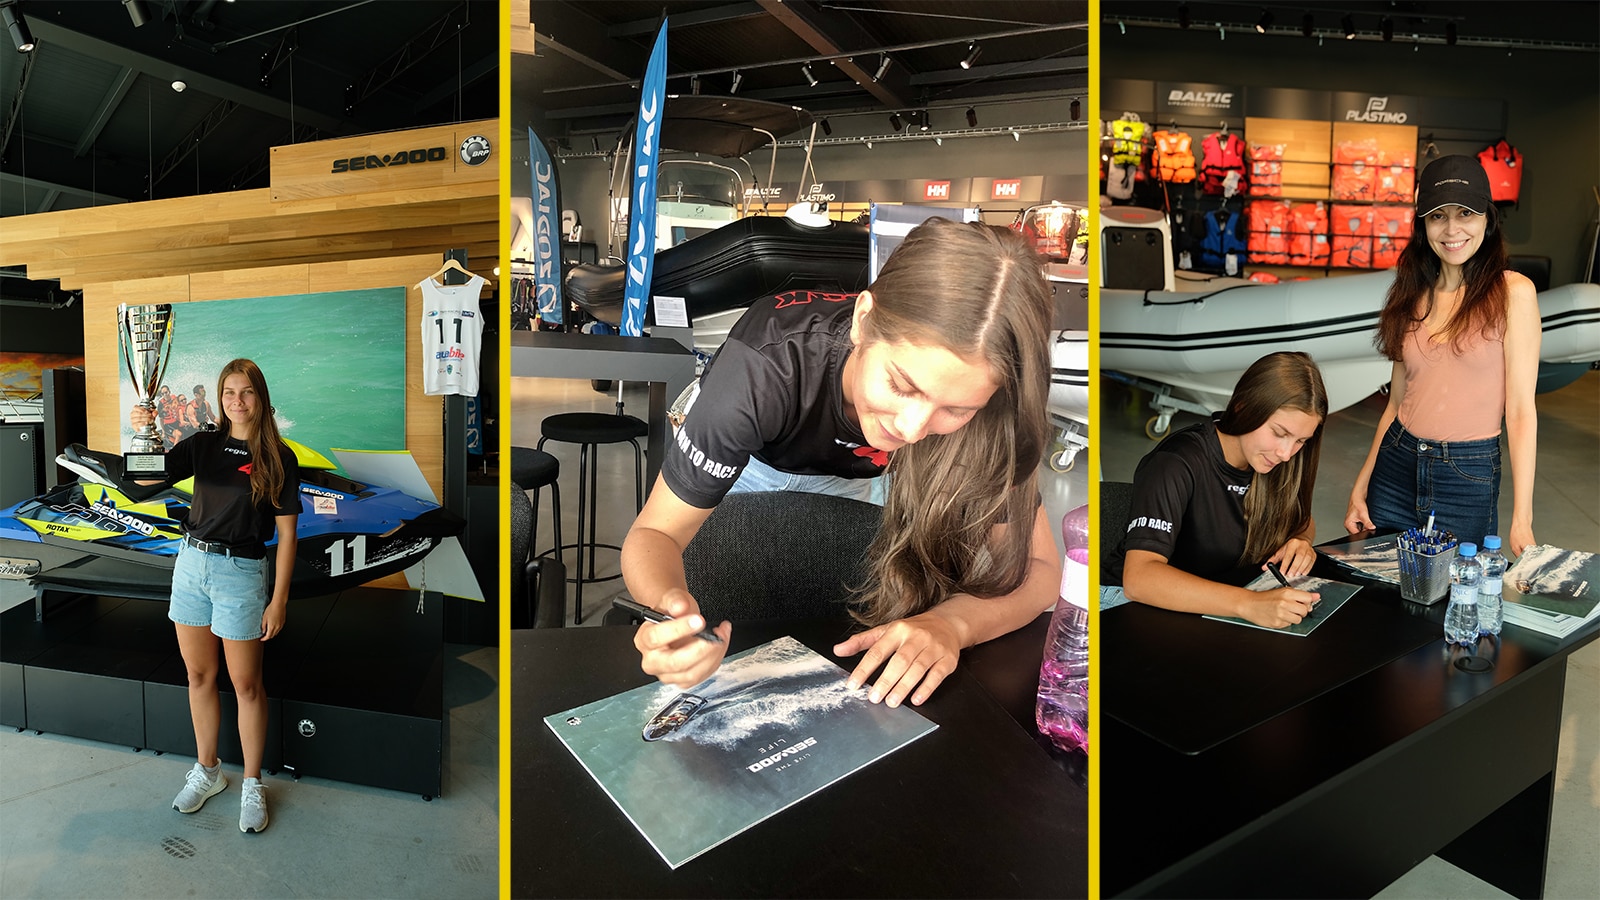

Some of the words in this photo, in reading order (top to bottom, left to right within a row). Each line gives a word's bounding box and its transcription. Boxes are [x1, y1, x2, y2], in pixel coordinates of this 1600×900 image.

[1168, 90, 1233, 103] BALTIC
[1346, 110, 1407, 124] PLASTIMO
[472, 149, 489, 158] BRP
[927, 184, 946, 197] HH
[995, 183, 1017, 196] HH
[224, 447, 248, 456] regio
[688, 447, 701, 468] TO
[46, 524, 70, 533] ROTAX
[1137, 516, 1148, 527] TO
[1148, 518, 1173, 533] RACE
[324, 535, 367, 577] 11
[758, 738, 787, 754] LIFE
[775, 762, 792, 772] THE
